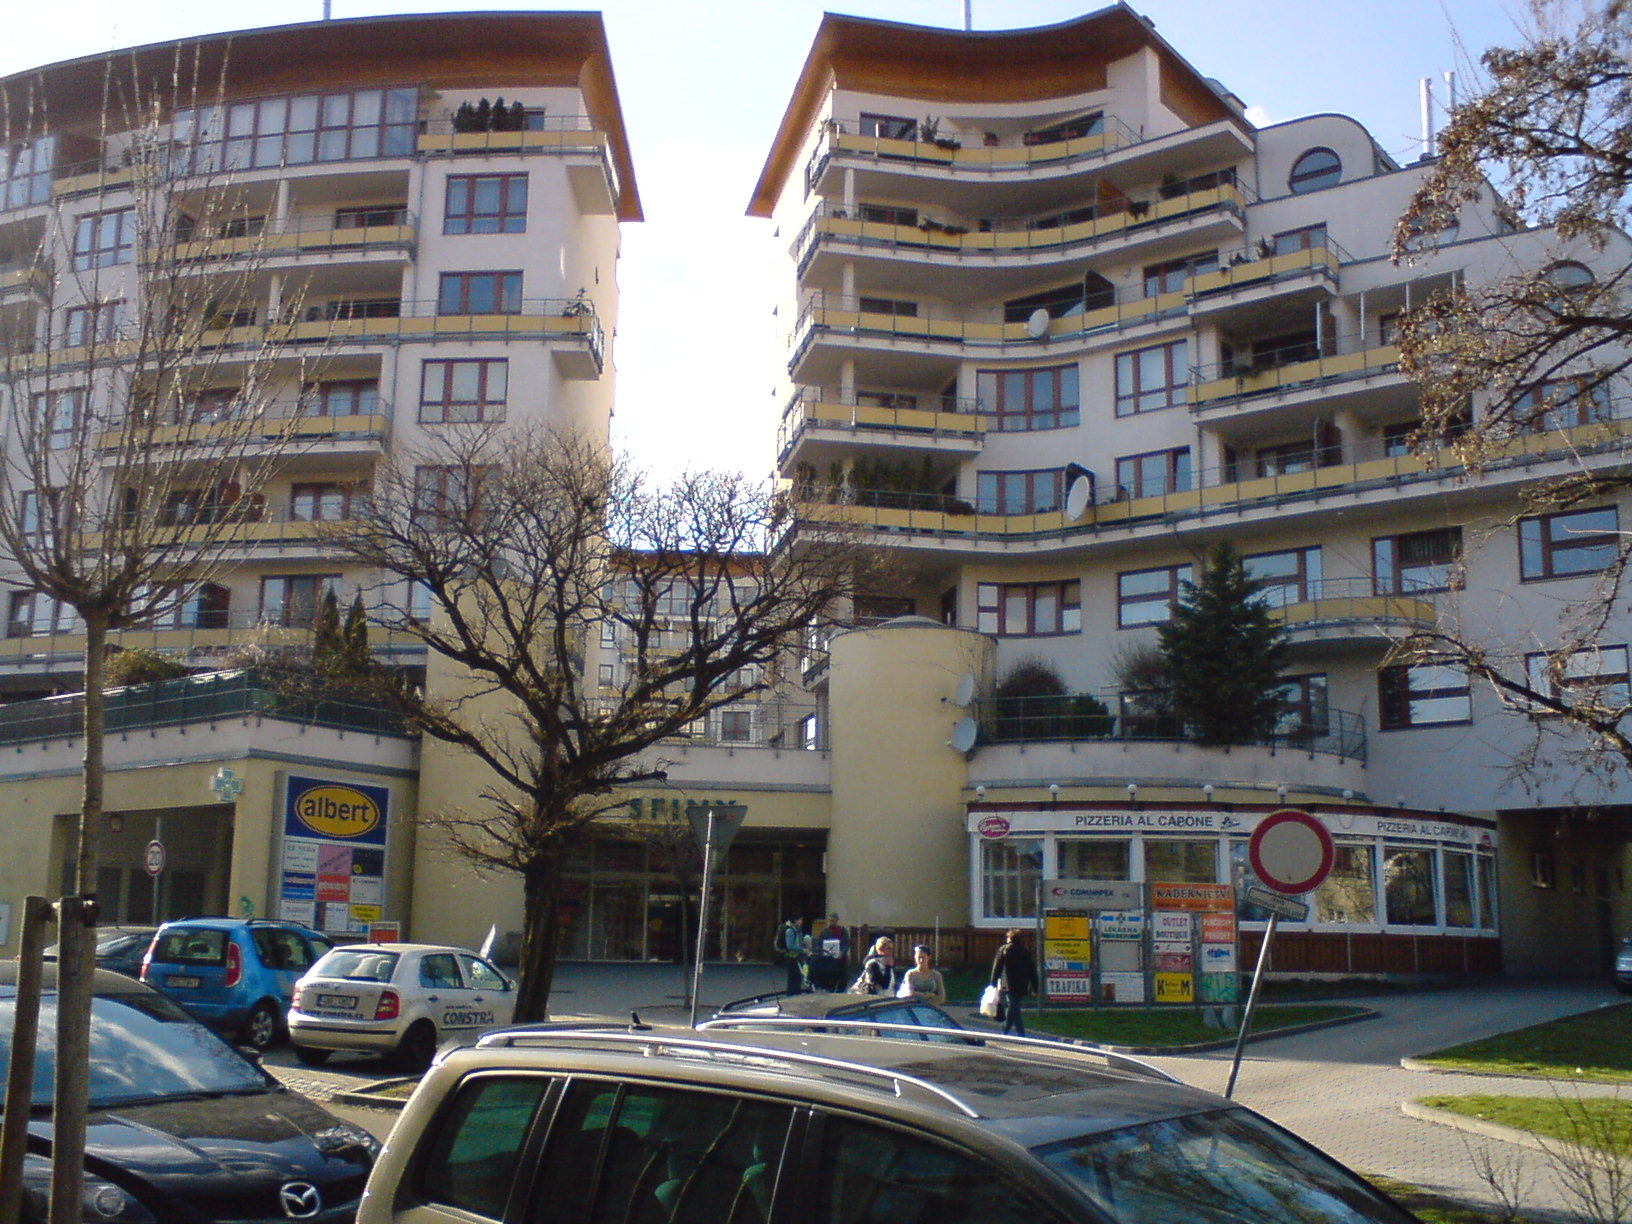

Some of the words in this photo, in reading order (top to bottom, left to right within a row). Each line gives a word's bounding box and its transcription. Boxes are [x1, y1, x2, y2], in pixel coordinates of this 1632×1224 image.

[303, 797, 370, 823] albert
[1075, 814, 1134, 827] PIZZERIA
[1137, 814, 1155, 827] AL
[1157, 814, 1214, 828] CAPONE
[1376, 820, 1418, 834] PIZZERIA
[1420, 825, 1432, 836] AL
[1161, 917, 1189, 927] OUTLET
[1050, 980, 1087, 993] TRAFIKA
